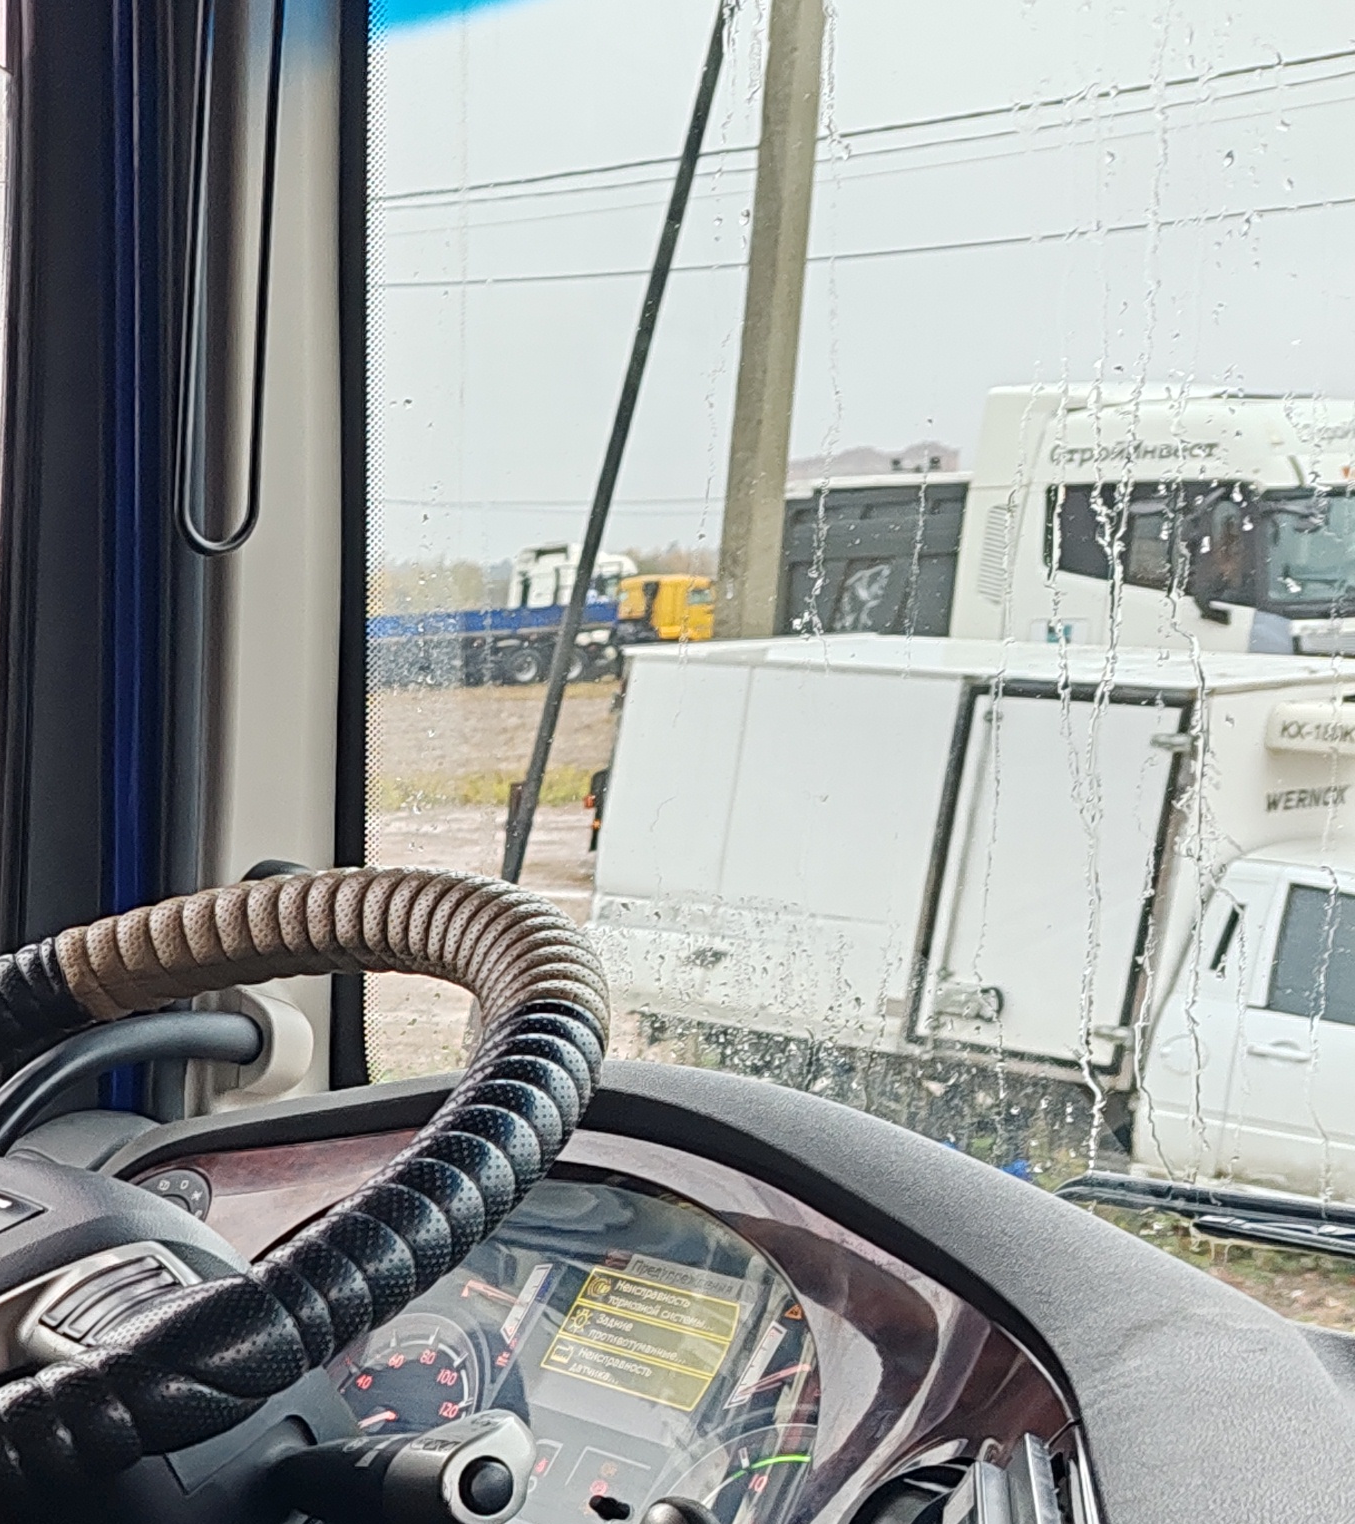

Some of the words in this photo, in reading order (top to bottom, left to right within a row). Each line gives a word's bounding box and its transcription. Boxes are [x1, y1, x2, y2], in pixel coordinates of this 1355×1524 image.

[632, 1259, 735, 1294] Предупредения
[615, 1279, 691, 1309] Неисправность
[607, 1294, 661, 1317] тормозной
[595, 1313, 634, 1332] Задние
[388, 1353, 406, 1369] 60
[418, 1349, 437, 1365] 80
[577, 1345, 652, 1377] Неисправность
[355, 1374, 373, 1390] 40
[436, 1369, 458, 1386] 100
[439, 1402, 459, 1418] 120
[748, 1473, 768, 1492] 10
